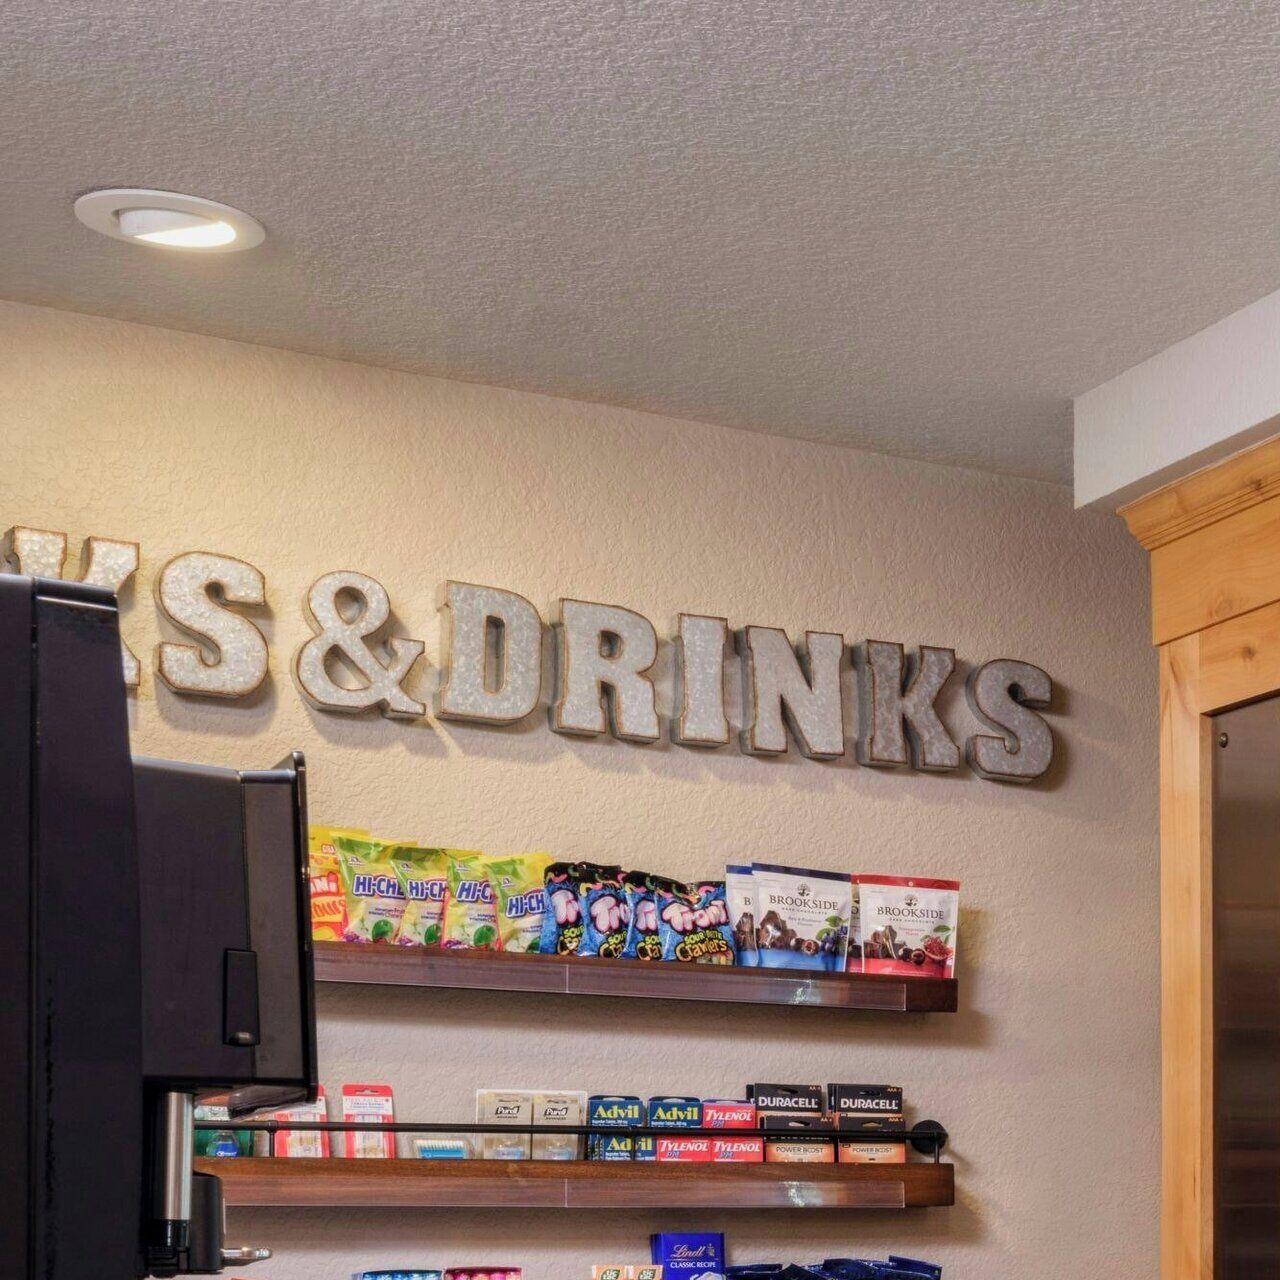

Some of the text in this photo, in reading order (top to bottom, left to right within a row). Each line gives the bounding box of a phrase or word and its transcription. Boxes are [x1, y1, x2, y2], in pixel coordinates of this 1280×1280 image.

[296, 570, 425, 717] &
[438, 580, 1055, 781] DRINKS
[769, 895, 839, 911] BROOKSIDE
[876, 907, 945, 920] BROOKSIDE
[758, 1096, 817, 1110] DURACELL
[840, 1098, 899, 1111] DURACELL
[593, 1104, 639, 1119] Advil
[653, 1106, 698, 1121] Advil
[705, 1109, 753, 1121] TYLENOL
[660, 1140, 709, 1152] TYLENOL
[713, 1140, 760, 1152] TYLENOL
[671, 1243, 705, 1259] Lindt
[670, 1260, 717, 1269] CLASSIC RECIPE
